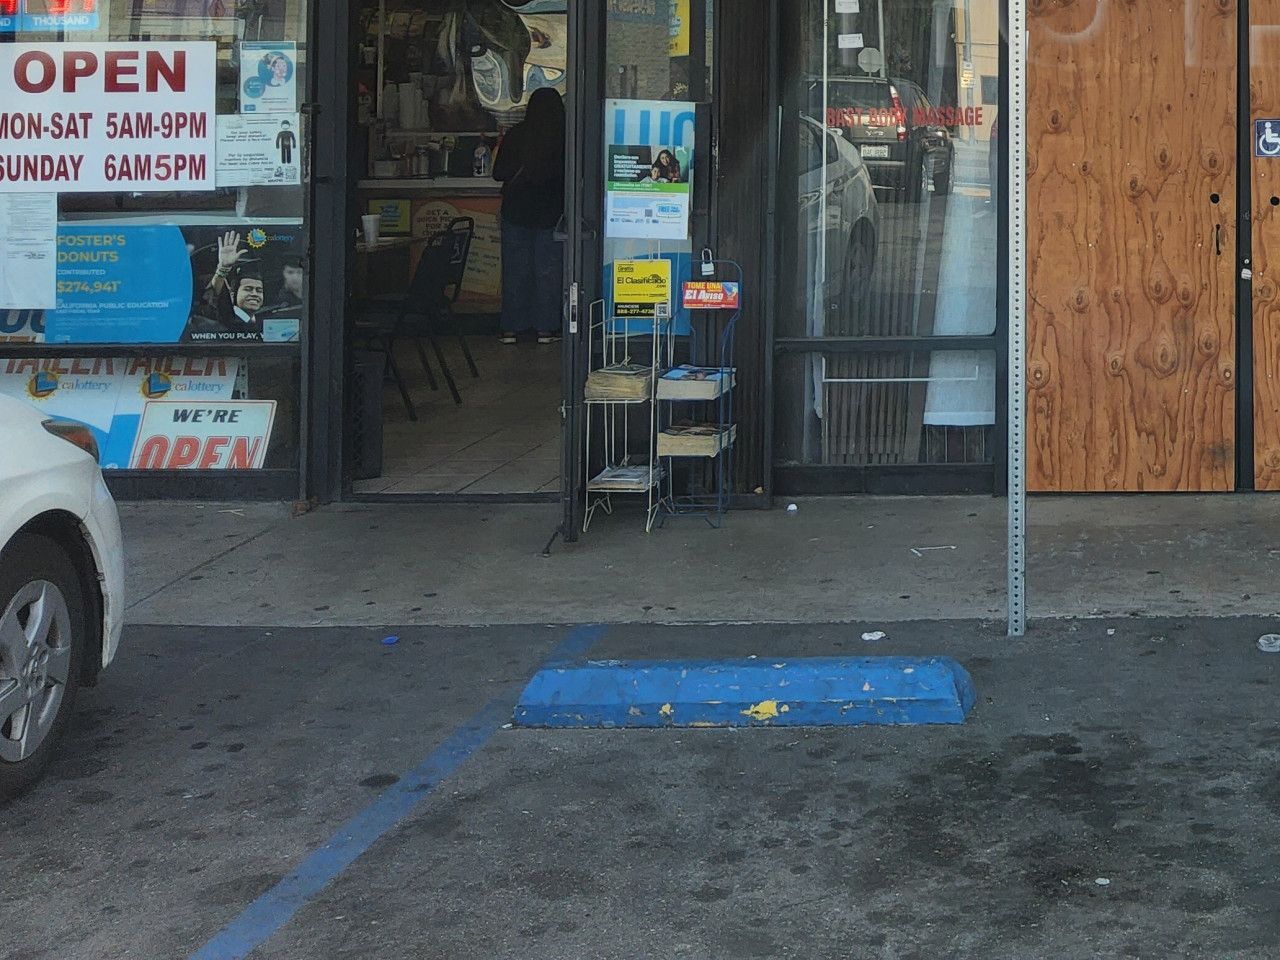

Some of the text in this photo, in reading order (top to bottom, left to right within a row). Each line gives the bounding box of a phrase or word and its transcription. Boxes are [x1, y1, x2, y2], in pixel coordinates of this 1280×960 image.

[33, 15, 89, 26] THOUSAND
[14, 50, 186, 94] OPEN
[912, 107, 983, 126] MASSAGE
[106, 112, 207, 139] 5AM-9PM
[104, 154, 206, 181] 6AM5PM
[57, 235, 126, 246] FOSTER'S
[57, 251, 119, 262] DONUTS
[626, 276, 666, 284] Clasificado
[685, 290, 723, 300] El Aviso
[173, 409, 242, 423] WE'RE
[134, 435, 263, 469] OPEN
